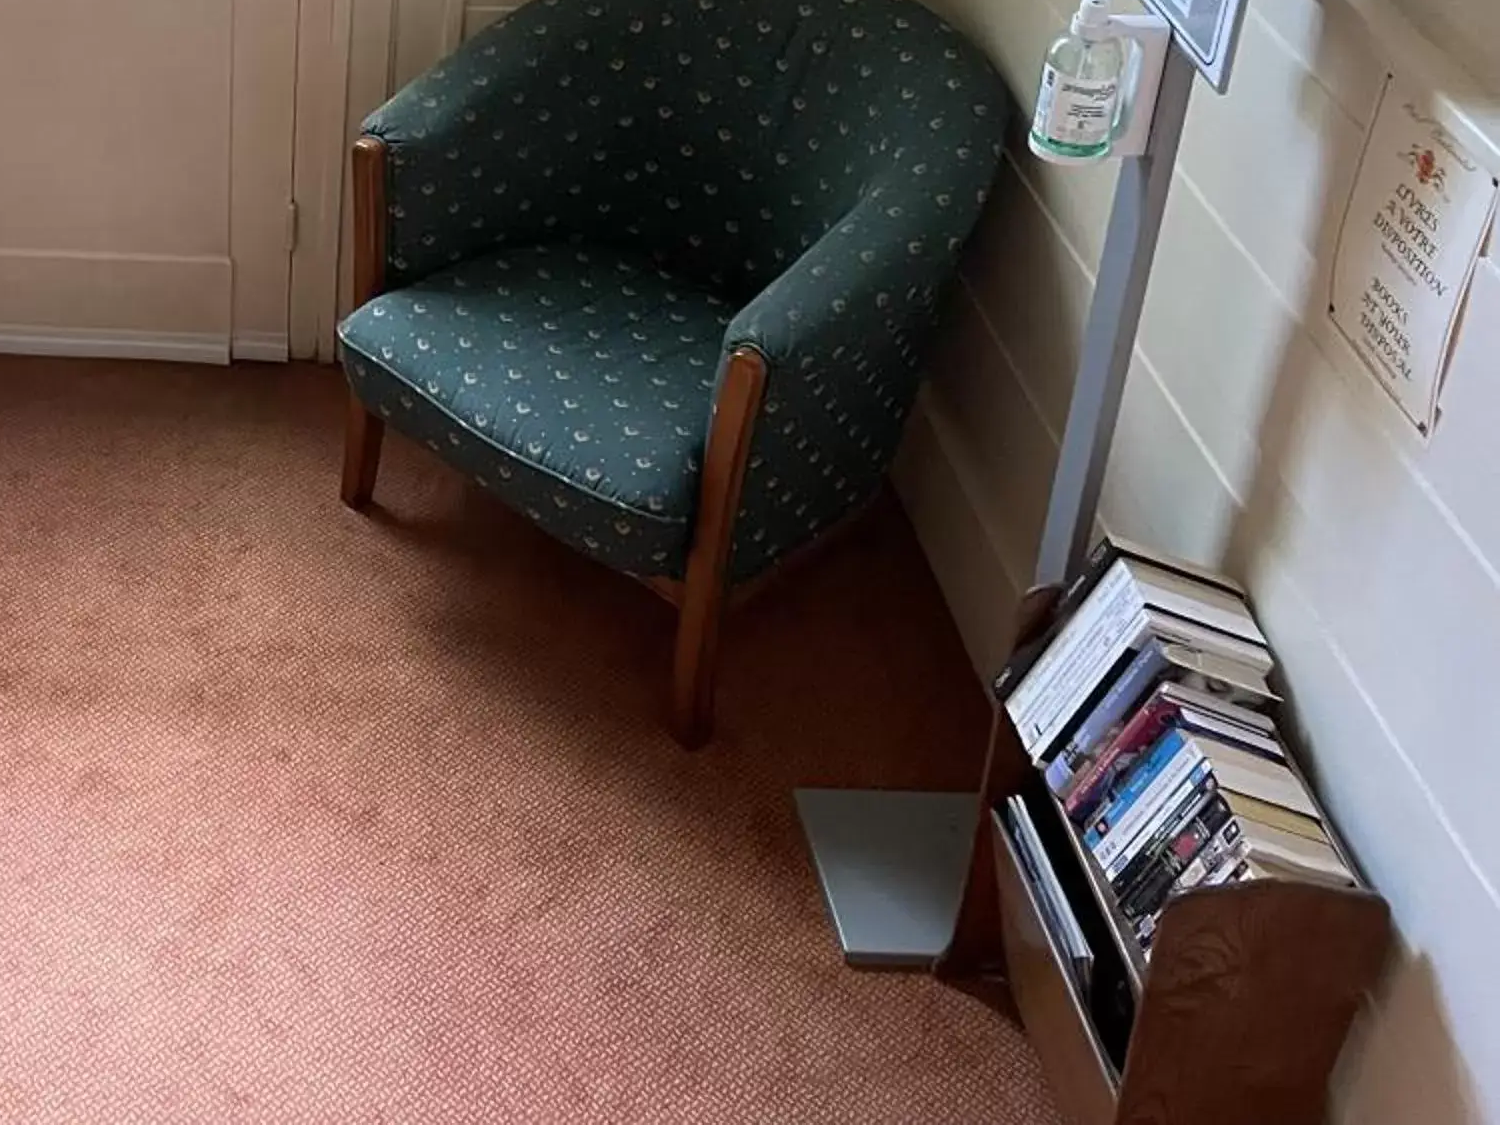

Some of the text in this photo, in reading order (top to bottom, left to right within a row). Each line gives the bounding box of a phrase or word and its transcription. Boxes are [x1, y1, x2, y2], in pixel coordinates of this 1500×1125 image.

[1395, 183, 1438, 232] LIVRES
[1400, 207, 1438, 257] VOTRE
[1374, 212, 1448, 296] DISPOSITION
[1361, 291, 1378, 313] AT
[1380, 310, 1411, 356] YOUR
[1371, 277, 1408, 326] BOOKS
[1360, 312, 1414, 381] DISPOSAL
